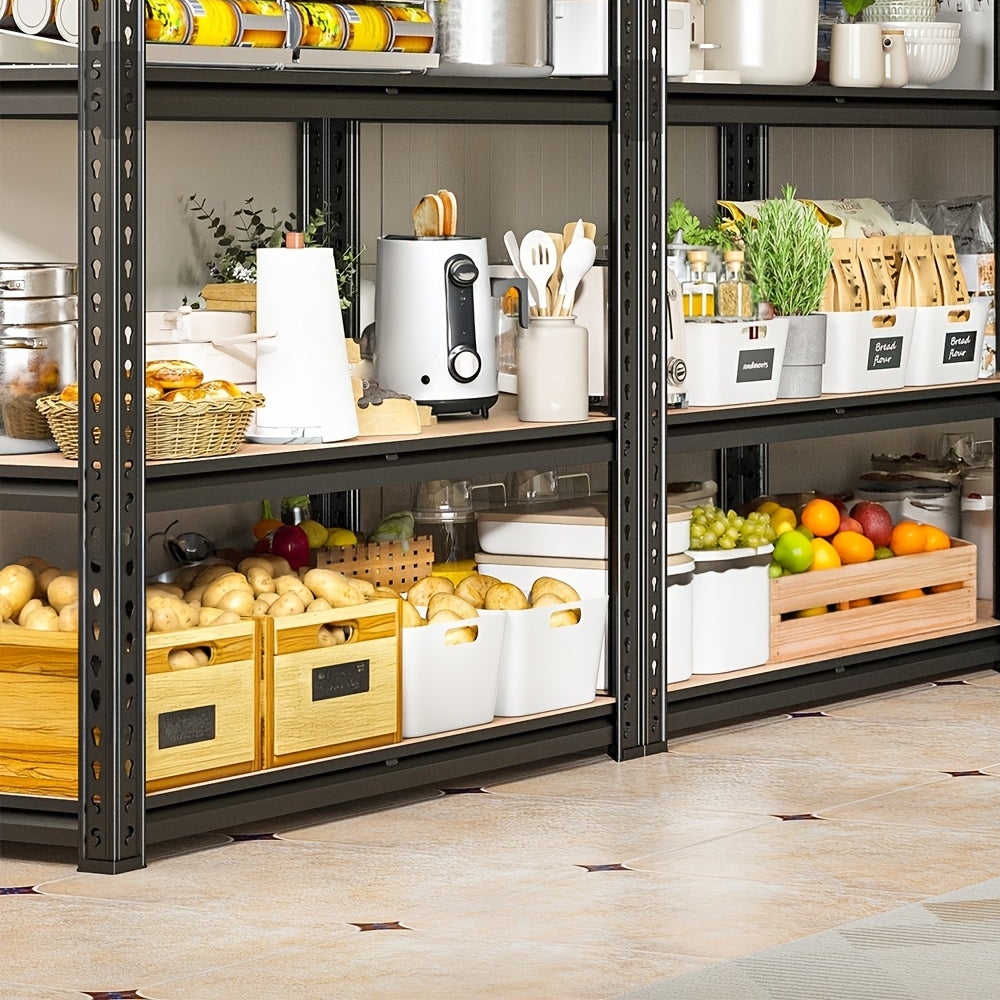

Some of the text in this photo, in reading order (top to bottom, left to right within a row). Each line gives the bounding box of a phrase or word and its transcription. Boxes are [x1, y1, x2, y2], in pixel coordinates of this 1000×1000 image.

[950, 335, 971, 346] Bread
[875, 342, 897, 352] Bread
[948, 348, 967, 360] flour
[873, 355, 893, 367] flour
